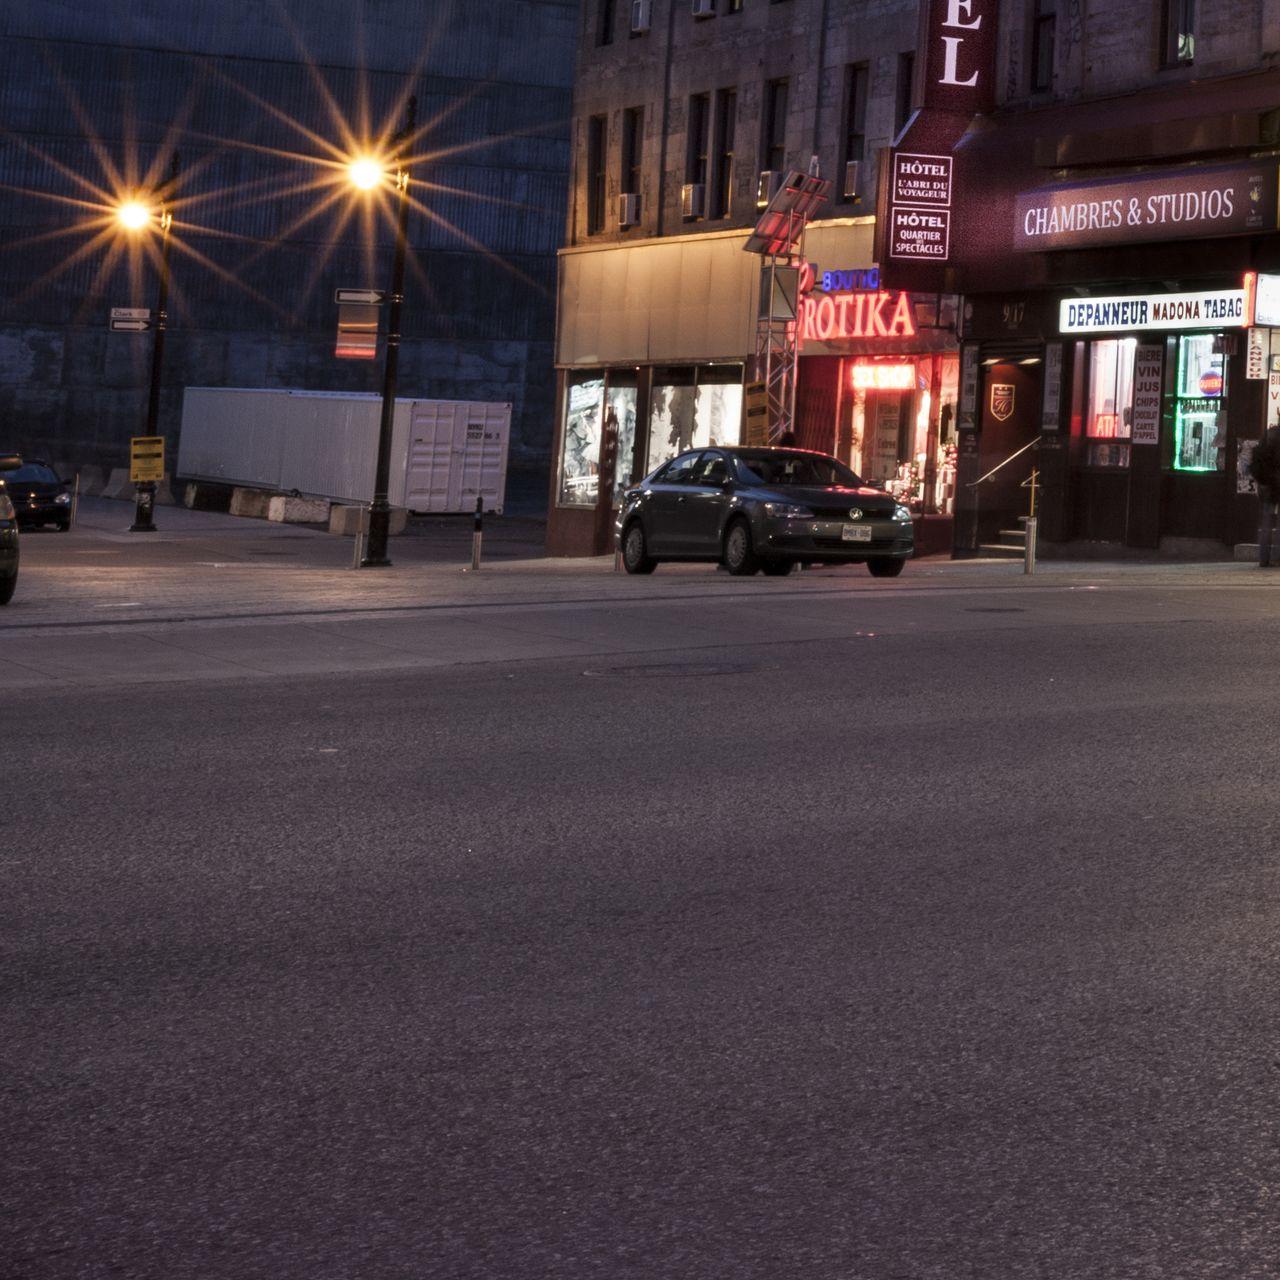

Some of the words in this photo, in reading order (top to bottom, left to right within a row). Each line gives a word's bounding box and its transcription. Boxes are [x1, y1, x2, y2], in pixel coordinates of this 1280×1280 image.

[900, 160, 948, 176] HÔTEL
[898, 180, 930, 189] L'ABRI
[933, 182, 948, 190] DU
[898, 188, 947, 199] VOYAGEUR
[1024, 199, 1123, 236] CHAMBRES
[1126, 197, 1143, 226] &
[1146, 188, 1234, 225] STUDIOS
[897, 213, 945, 228] HÔTEL
[900, 230, 940, 240] QUARTIER
[895, 243, 944, 254] SPECTACLES
[1068, 300, 1149, 327] DEPANNEUR
[1152, 301, 1201, 321] MADONA
[1204, 298, 1243, 319] TABAG
[1138, 350, 1161, 362] BIERE
[1138, 367, 1161, 377] VIN
[1137, 382, 1160, 392] JUS
[1136, 398, 1158, 407] CHIPS
[1136, 423, 1154, 431] CARTE
[1134, 432, 1157, 440] D'APPEL
